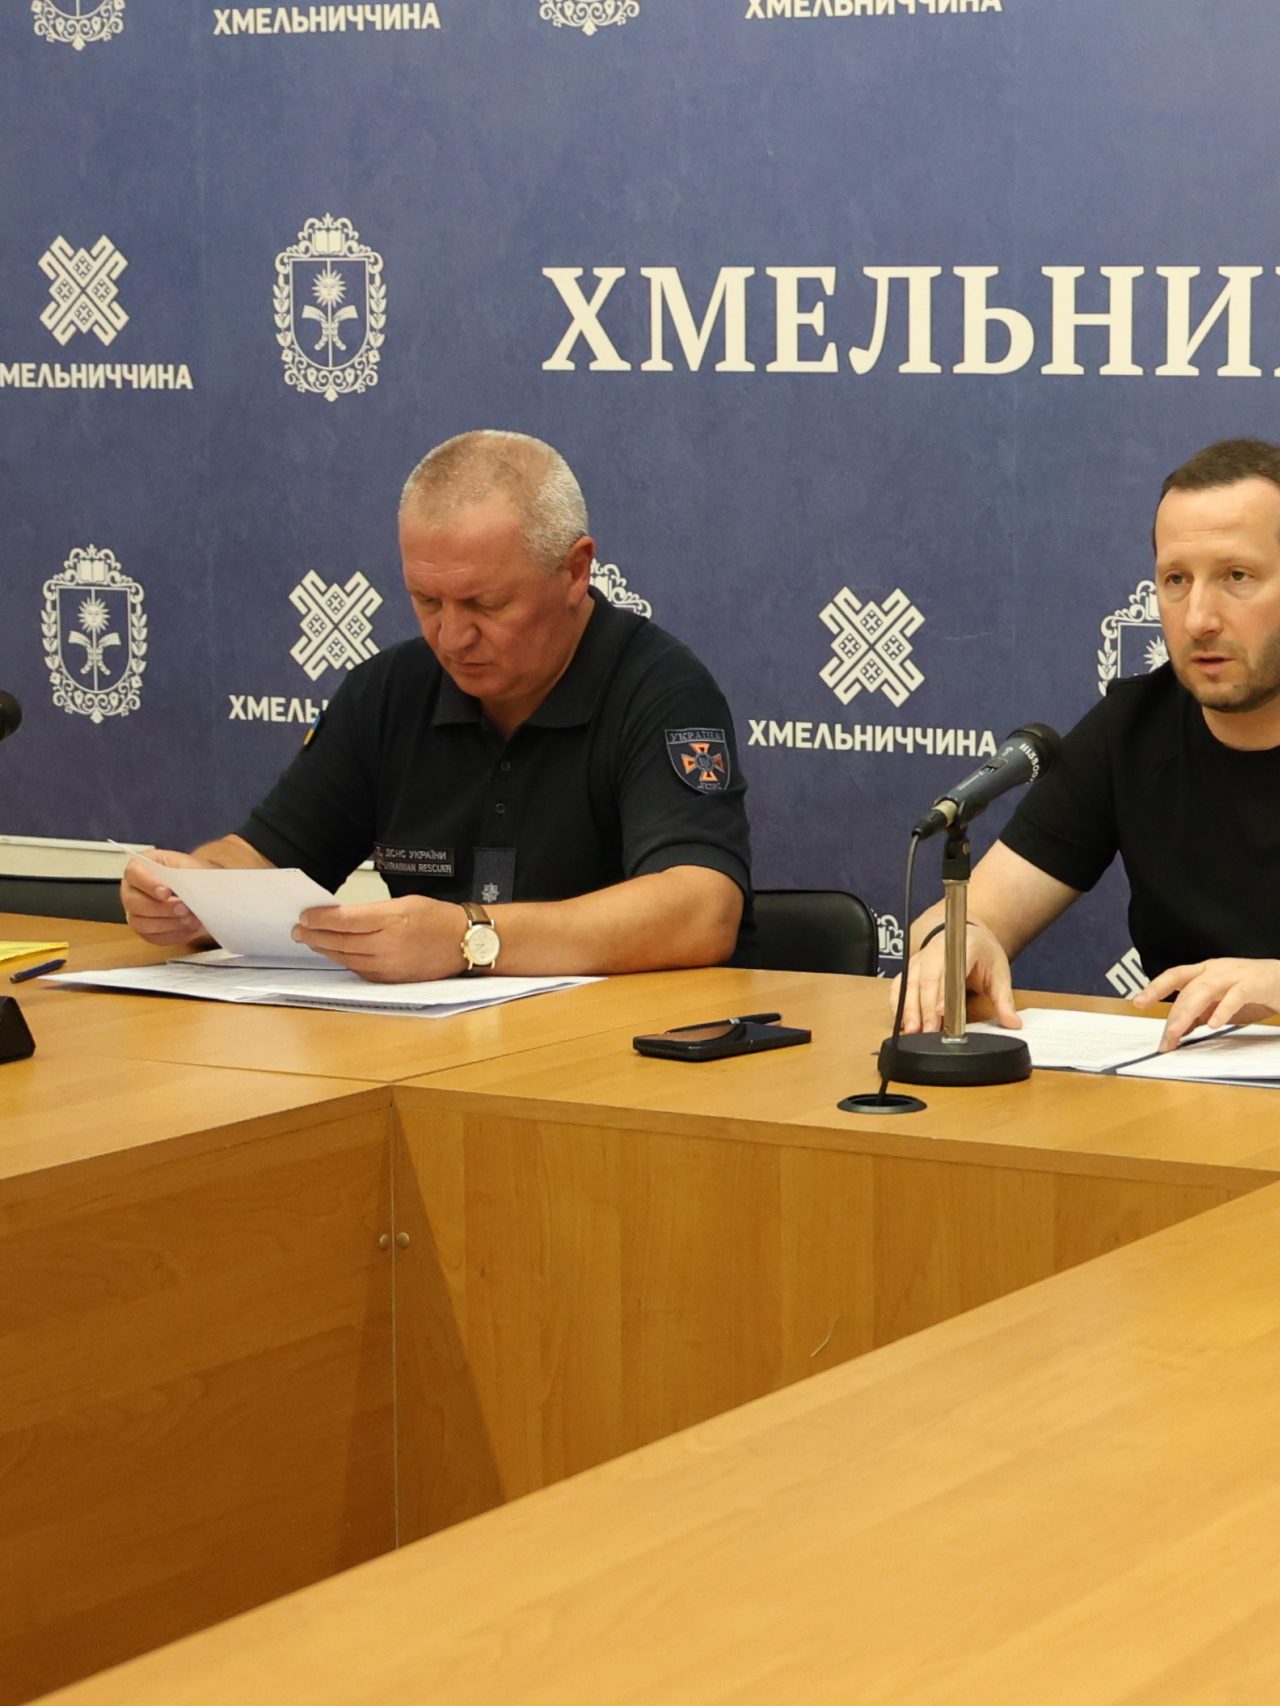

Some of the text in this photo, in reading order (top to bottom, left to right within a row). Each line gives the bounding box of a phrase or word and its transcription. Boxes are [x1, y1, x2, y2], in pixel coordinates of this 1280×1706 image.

[213, 2, 441, 35] ХМЕЛЬНИЧЧИНА
[228, 694, 329, 724] ХМЕЛЬ
[747, 719, 998, 757] ХМЕЛЬНИЧЧИНА
[409, 849, 447, 861] УКРАЇНИ
[418, 863, 452, 874] RESCUER
